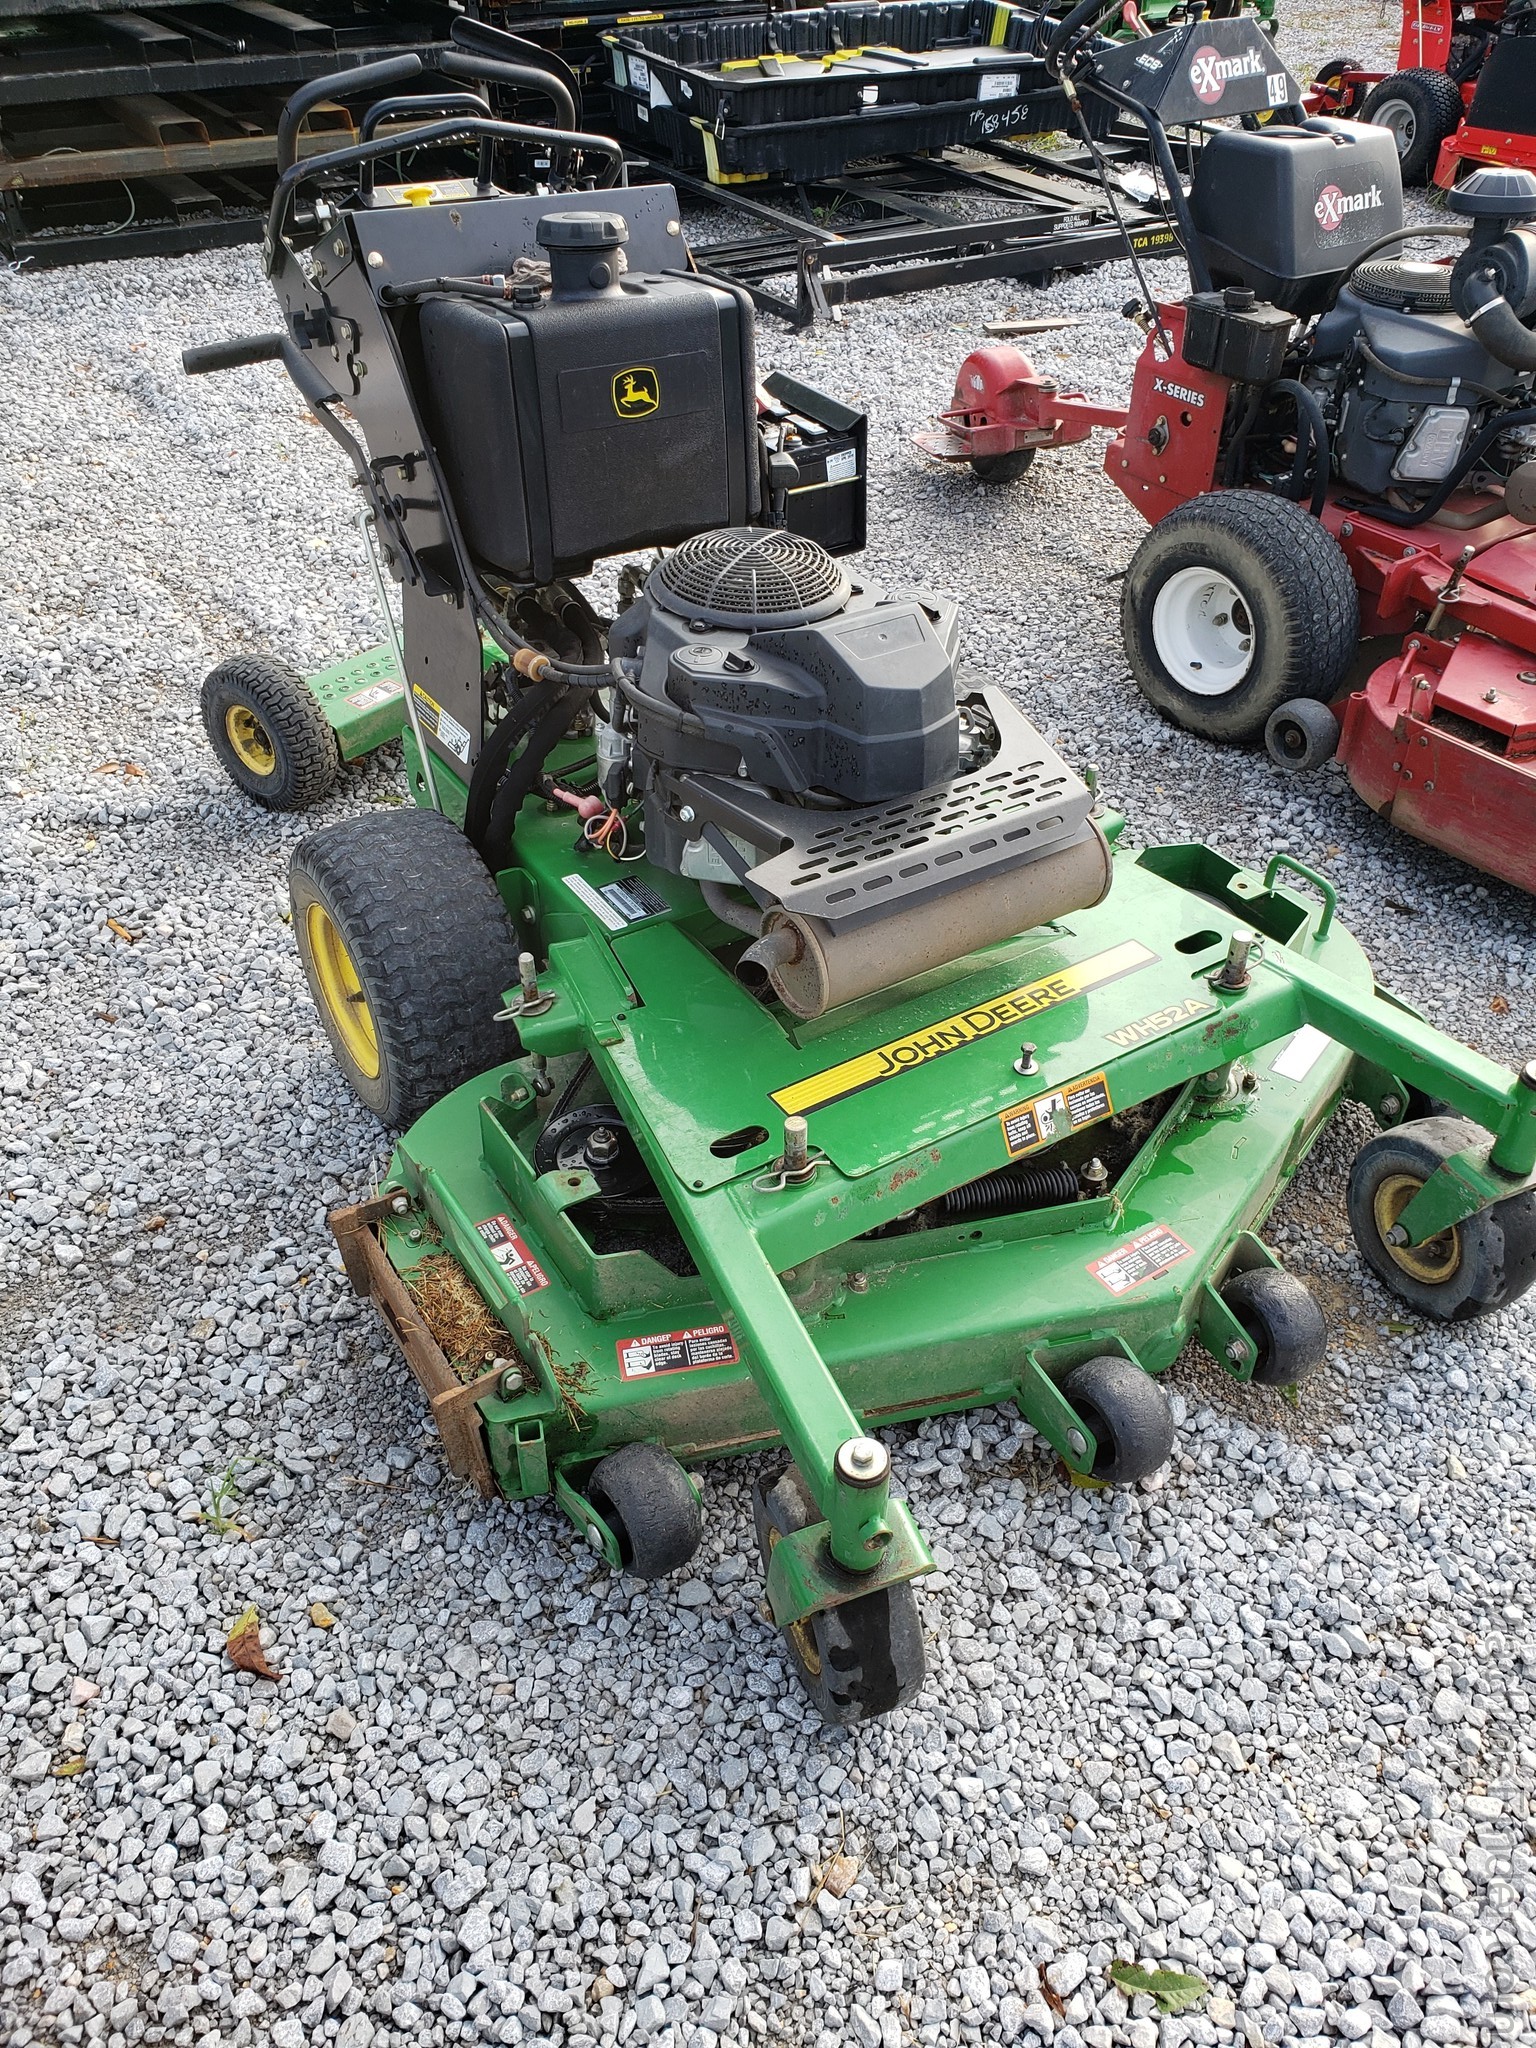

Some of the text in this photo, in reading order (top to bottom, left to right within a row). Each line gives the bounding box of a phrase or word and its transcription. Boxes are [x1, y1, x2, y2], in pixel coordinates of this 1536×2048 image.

[1269, 75, 1287, 103] 49
[1133, 236, 1148, 249] TCA
[1153, 377, 1206, 408] X-SERIES
[877, 978, 1076, 1075] JOHN DEERE
[1104, 998, 1214, 1049] WH52A
[500, 1219, 518, 1240] DANGER
[529, 1264, 548, 1286] PELIGRO
[692, 1325, 725, 1336] PELIGRO
